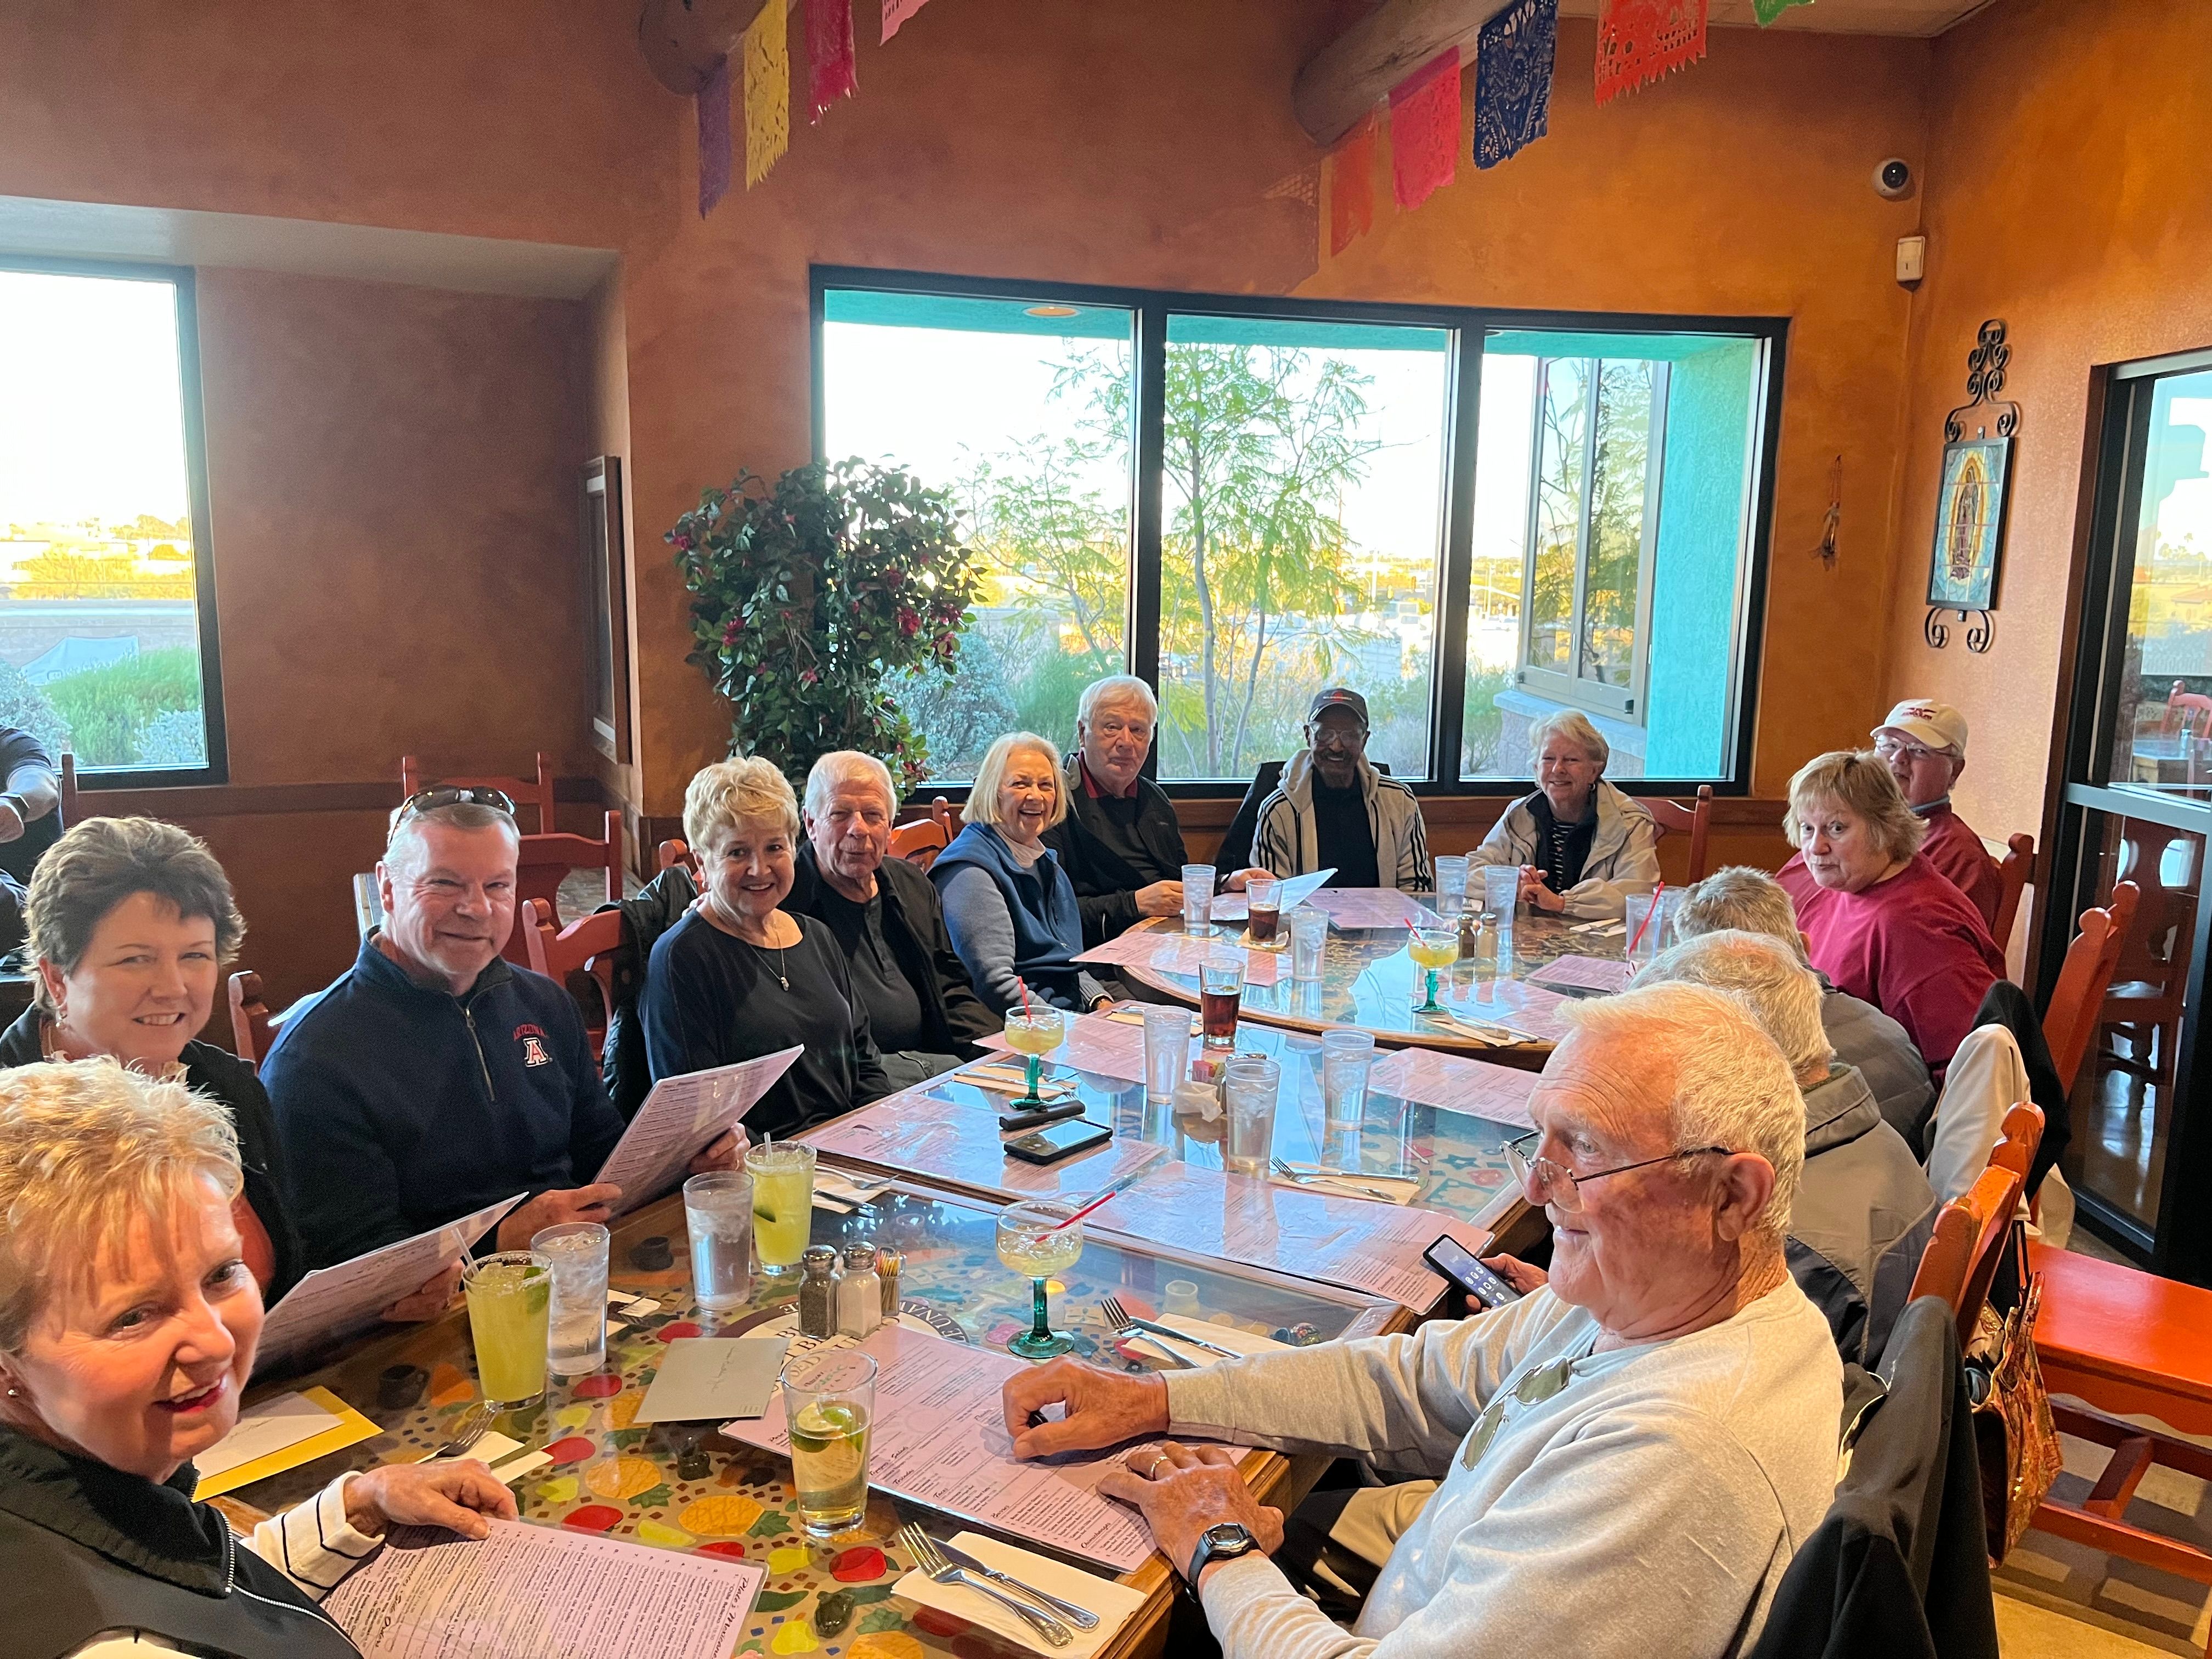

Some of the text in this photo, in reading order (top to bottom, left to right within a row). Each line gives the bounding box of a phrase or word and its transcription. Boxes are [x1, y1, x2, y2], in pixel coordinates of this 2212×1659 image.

[523, 1037, 549, 1068] A
[933, 1488, 948, 1498] Tacos
[991, 1505, 1009, 1518] Burros
[562, 1563, 578, 1590] Enchiladas
[576, 1570, 591, 1598] Enchiladas
[592, 1573, 607, 1601] Enchiladas
[612, 1577, 627, 1606] Enchiladas
[628, 1581, 642, 1609] Enchiladas
[644, 1584, 658, 1612] Enchiladas
[661, 1585, 676, 1613] Enchiladas
[375, 1617, 391, 1647] Orders
[579, 1612, 589, 1628] Carne
[600, 1617, 609, 1633] Carne
[632, 1624, 641, 1640] Carne
[692, 1612, 700, 1626] Chile
[612, 1621, 624, 1645] Machaca
[648, 1625, 658, 1644] Queso
[667, 1627, 676, 1643] Chiles
[681, 1628, 693, 1655] Colorado
[711, 1612, 736, 1659] Mexicano
